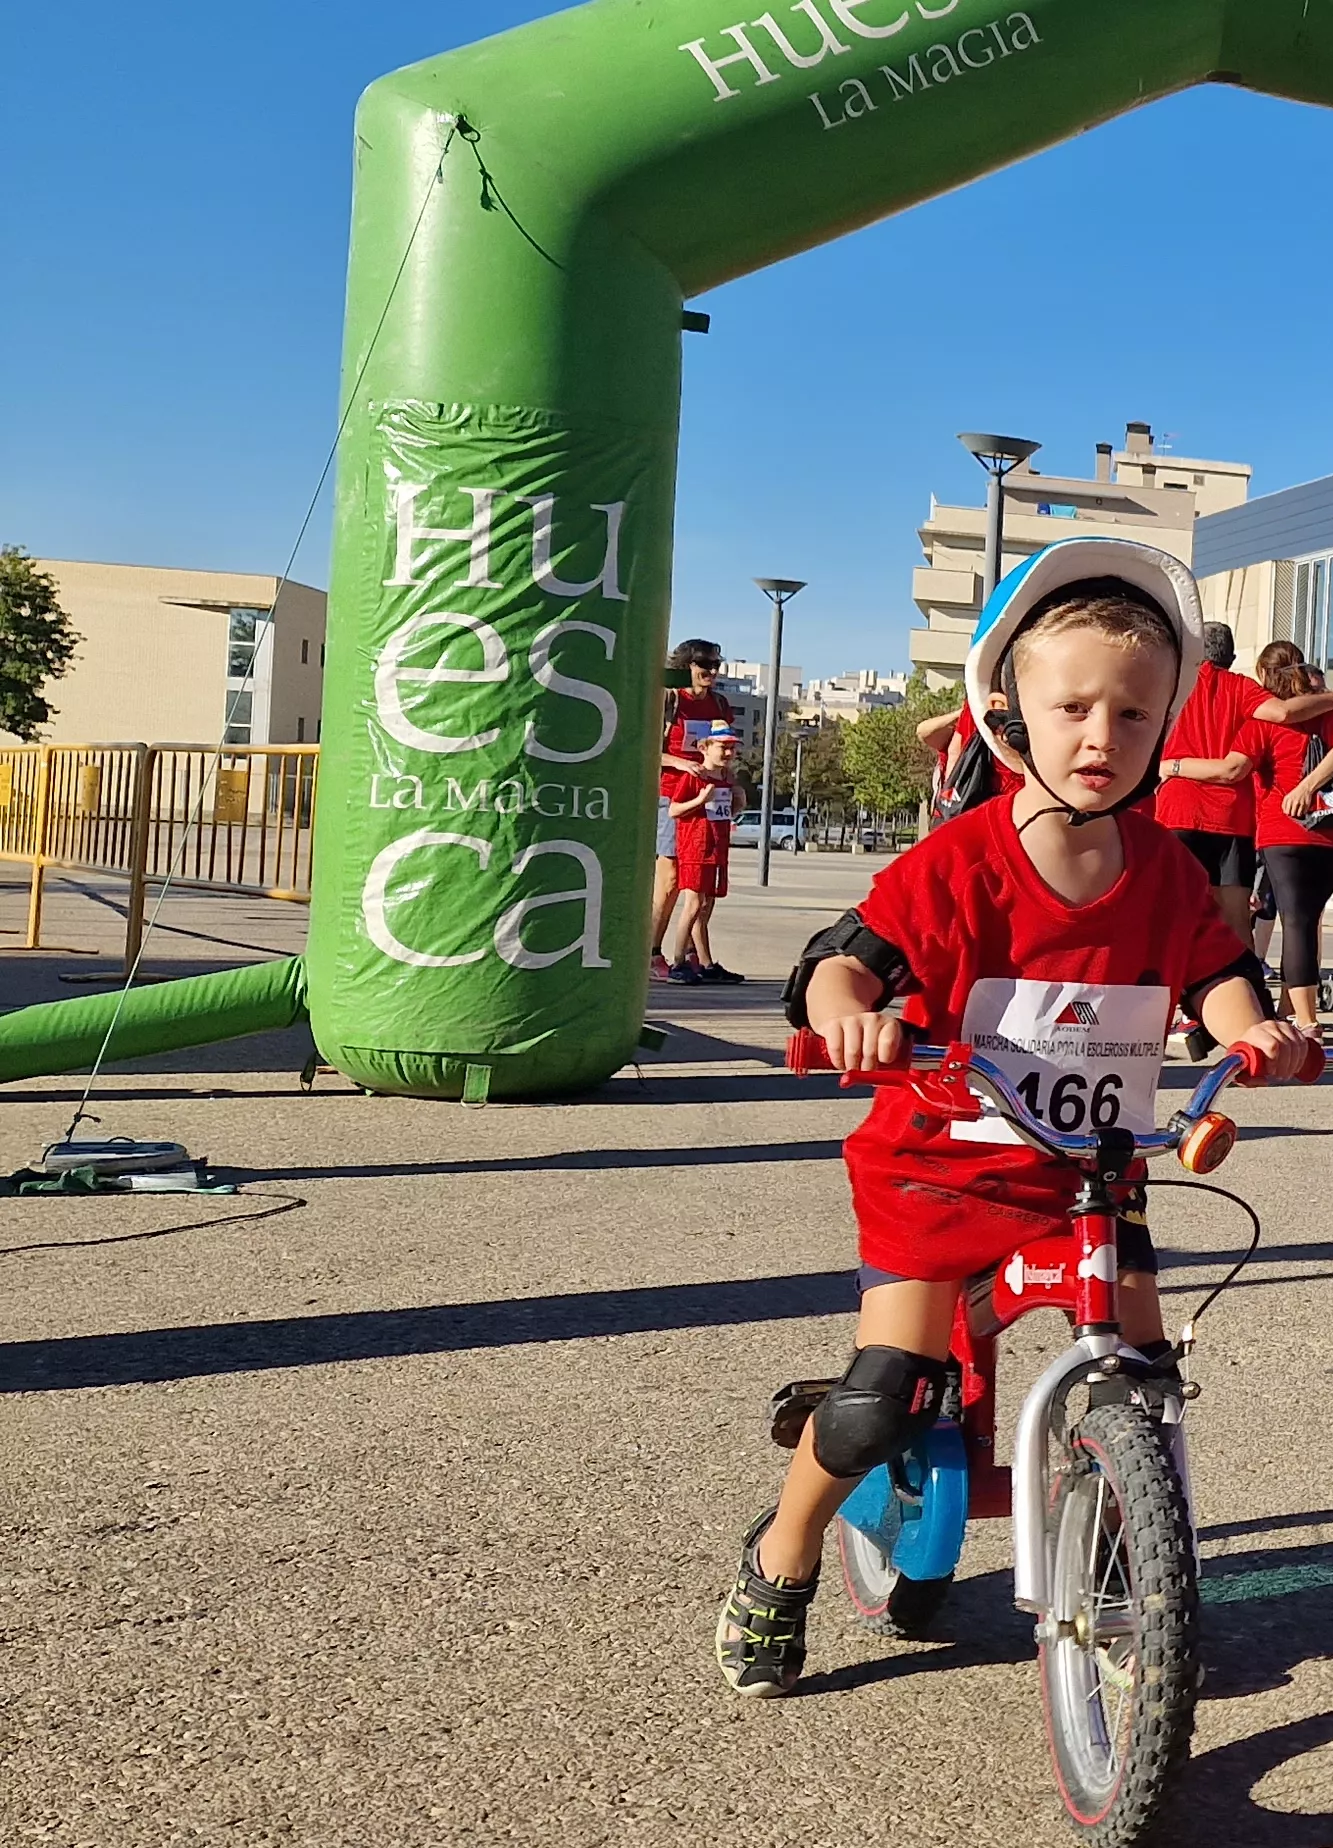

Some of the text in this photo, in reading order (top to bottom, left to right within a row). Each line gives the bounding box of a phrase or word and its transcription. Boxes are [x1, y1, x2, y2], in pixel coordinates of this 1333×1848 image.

[807, 77, 879, 131] La
[381, 483, 630, 601] Hu
[372, 610, 619, 764] es
[368, 772, 427, 810] La
[361, 831, 612, 970] ca
[973, 1034, 1009, 1051] MARCHA
[1011, 1037, 1055, 1055] SOLIDARIA
[1057, 1040, 1075, 1057] POR
[1075, 1042, 1086, 1057] LA
[1086, 1041, 1130, 1058] ESCLEROSIS
[1055, 1025, 1091, 1034] AODEM
[1016, 1071, 1124, 1133] 466
